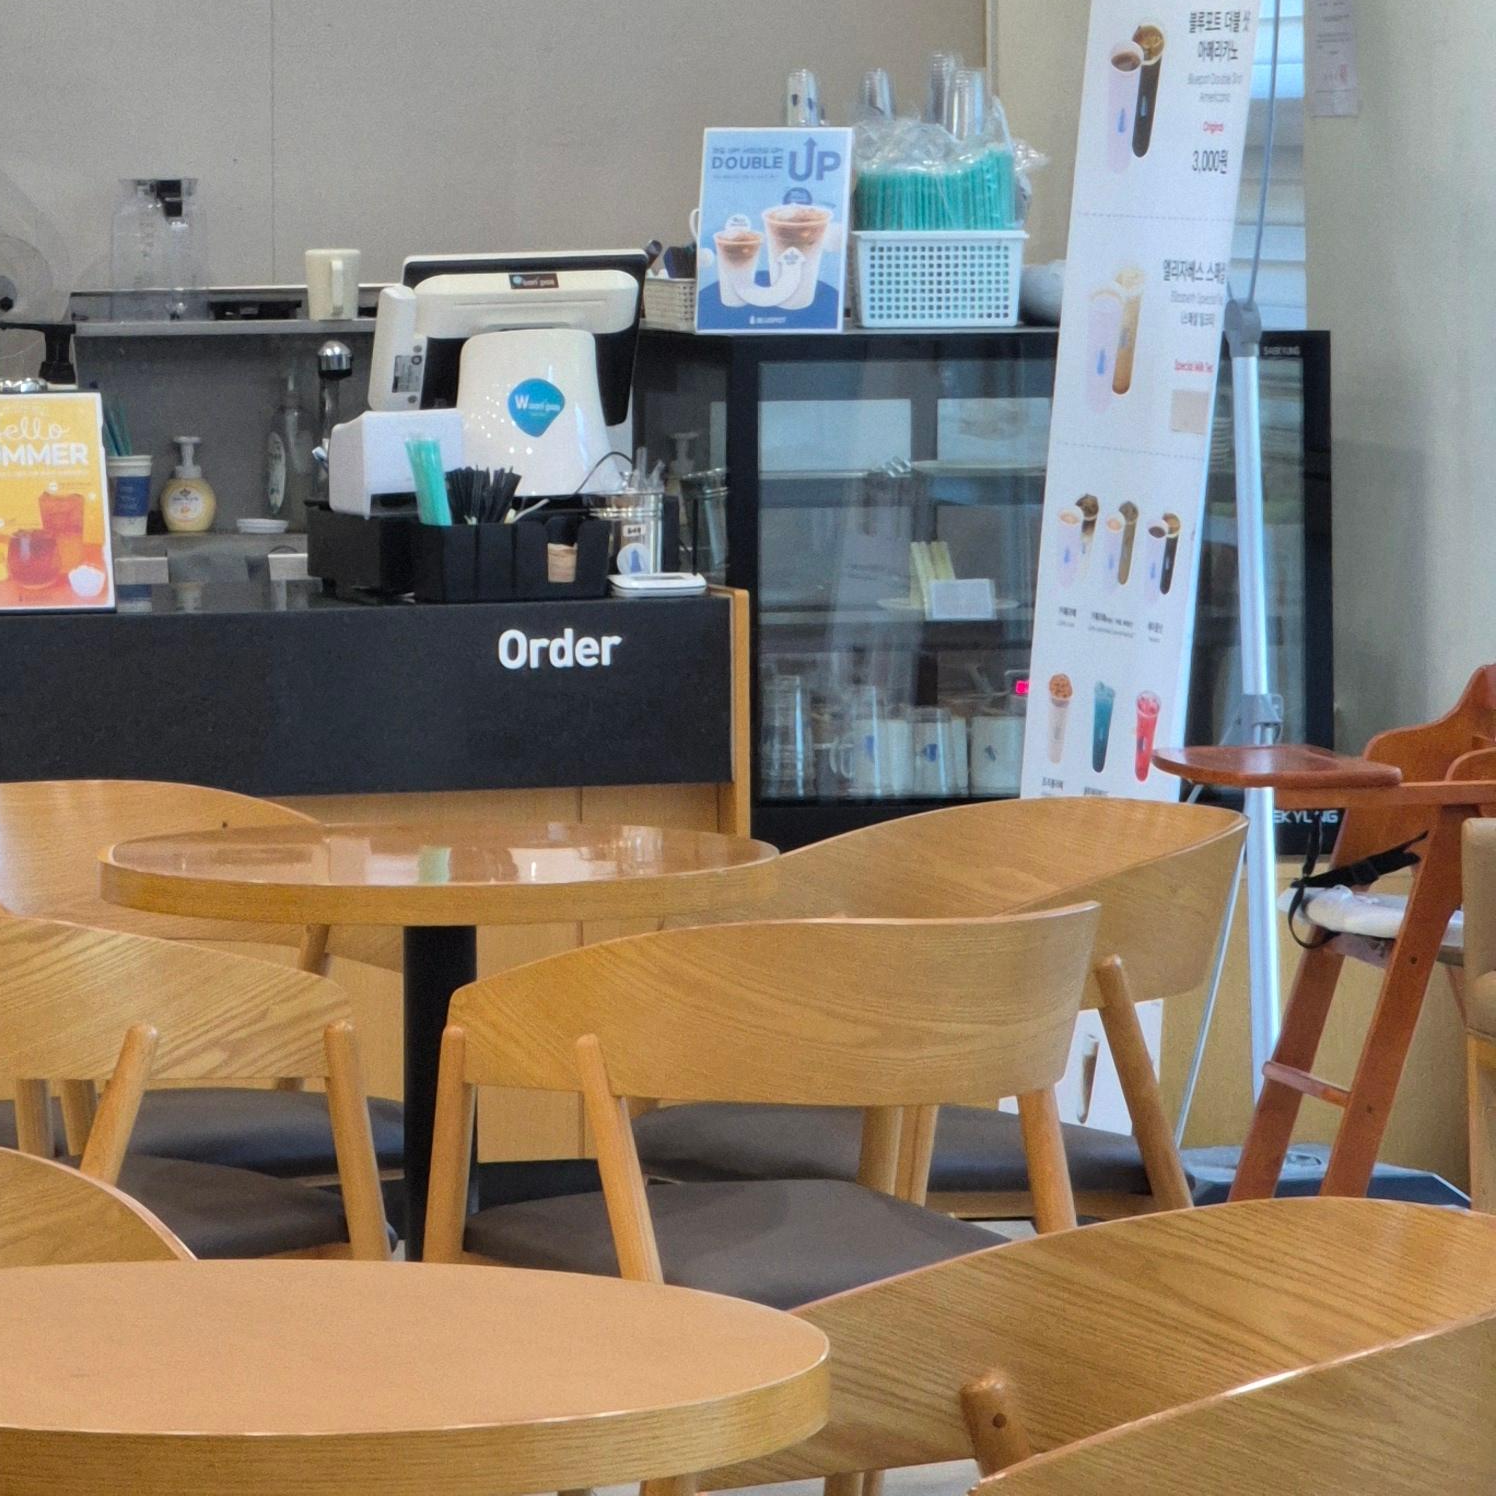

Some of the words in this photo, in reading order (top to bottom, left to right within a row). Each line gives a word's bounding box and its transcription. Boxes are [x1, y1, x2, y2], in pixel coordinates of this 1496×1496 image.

[711, 155, 784, 170] DOUBLE
[788, 137, 842, 182] UP
[1191, 148, 1228, 175] 3,000원
[498, 628, 623, 670] Order
